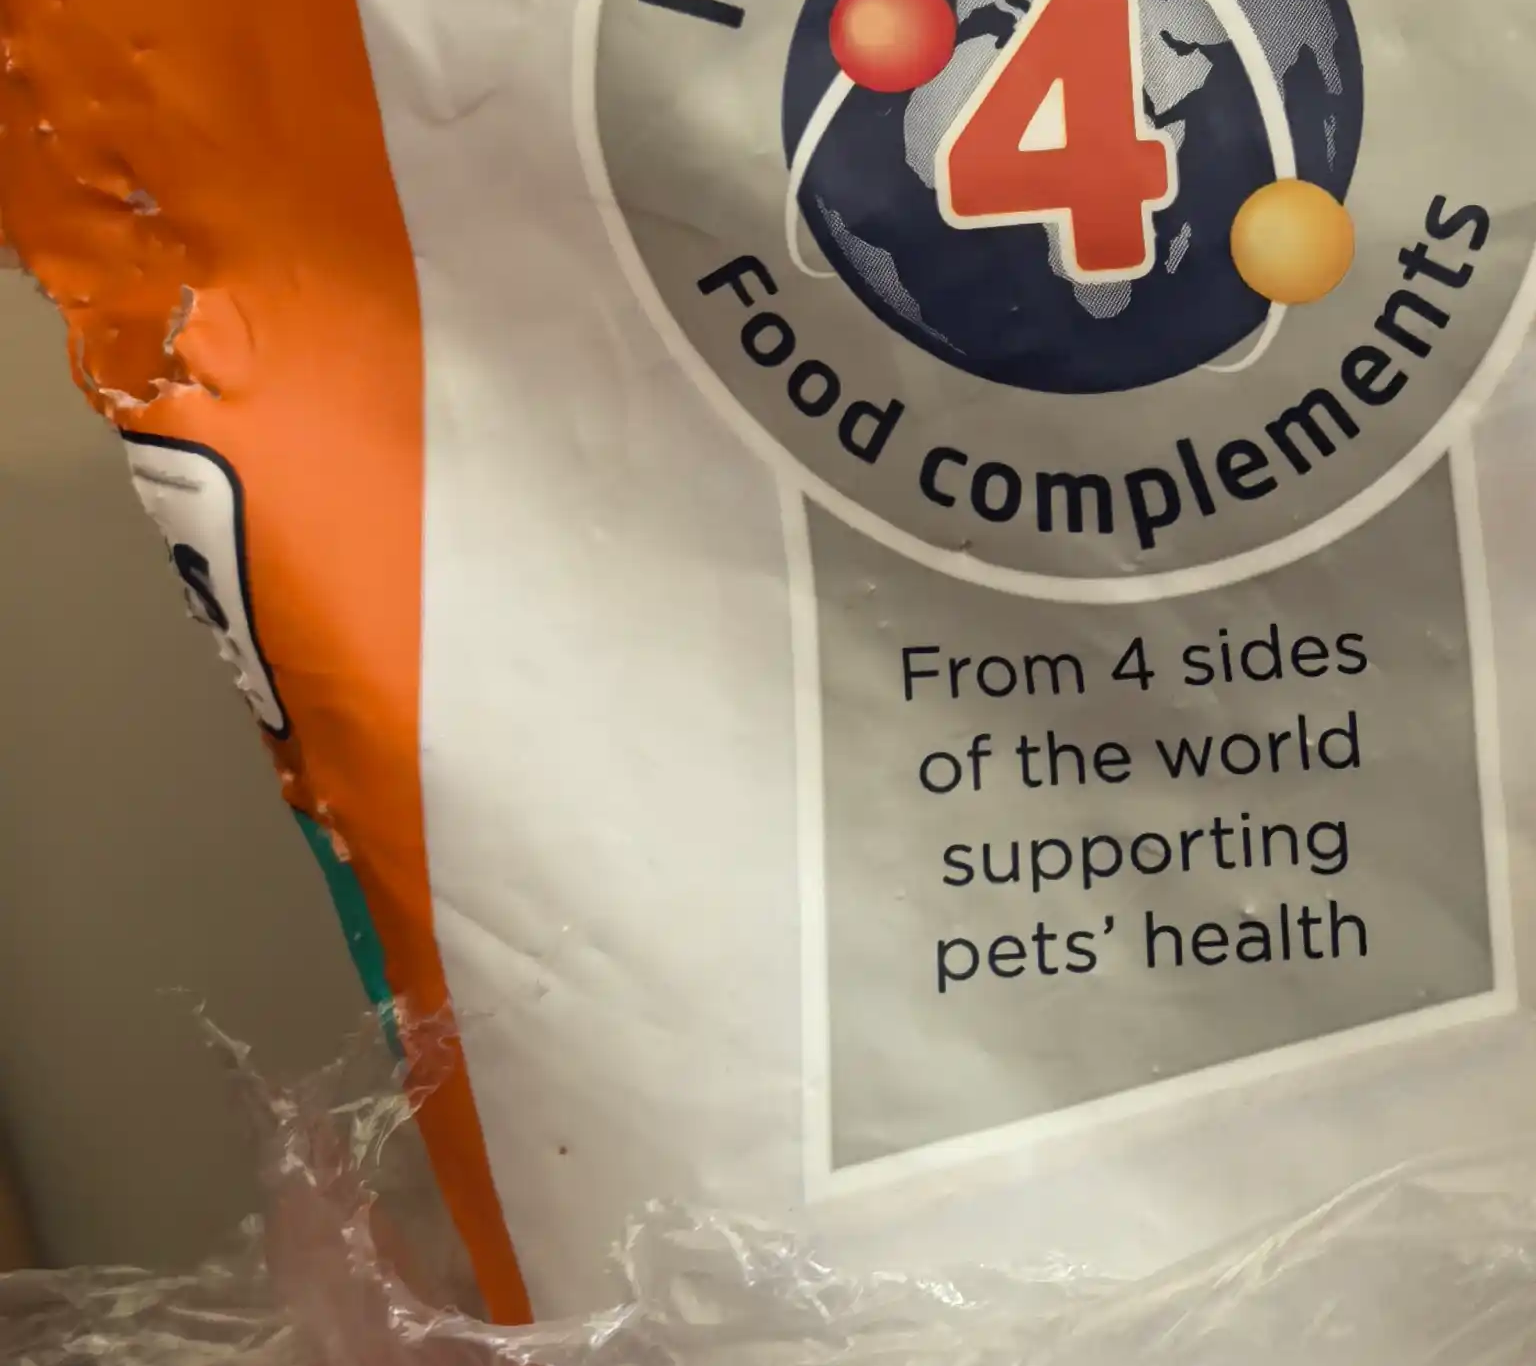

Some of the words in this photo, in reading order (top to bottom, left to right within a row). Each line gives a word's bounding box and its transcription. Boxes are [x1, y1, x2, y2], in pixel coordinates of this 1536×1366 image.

[697, 254, 905, 463] Food
[918, 193, 1491, 549] complements
[902, 645, 1085, 701] From
[1111, 637, 1154, 691] 4
[1182, 623, 1368, 685] sides
[919, 734, 992, 793] of
[1016, 730, 1131, 788] the
[1155, 711, 1359, 778] world
[943, 813, 1348, 892] supporting
[1146, 900, 1366, 968] health
